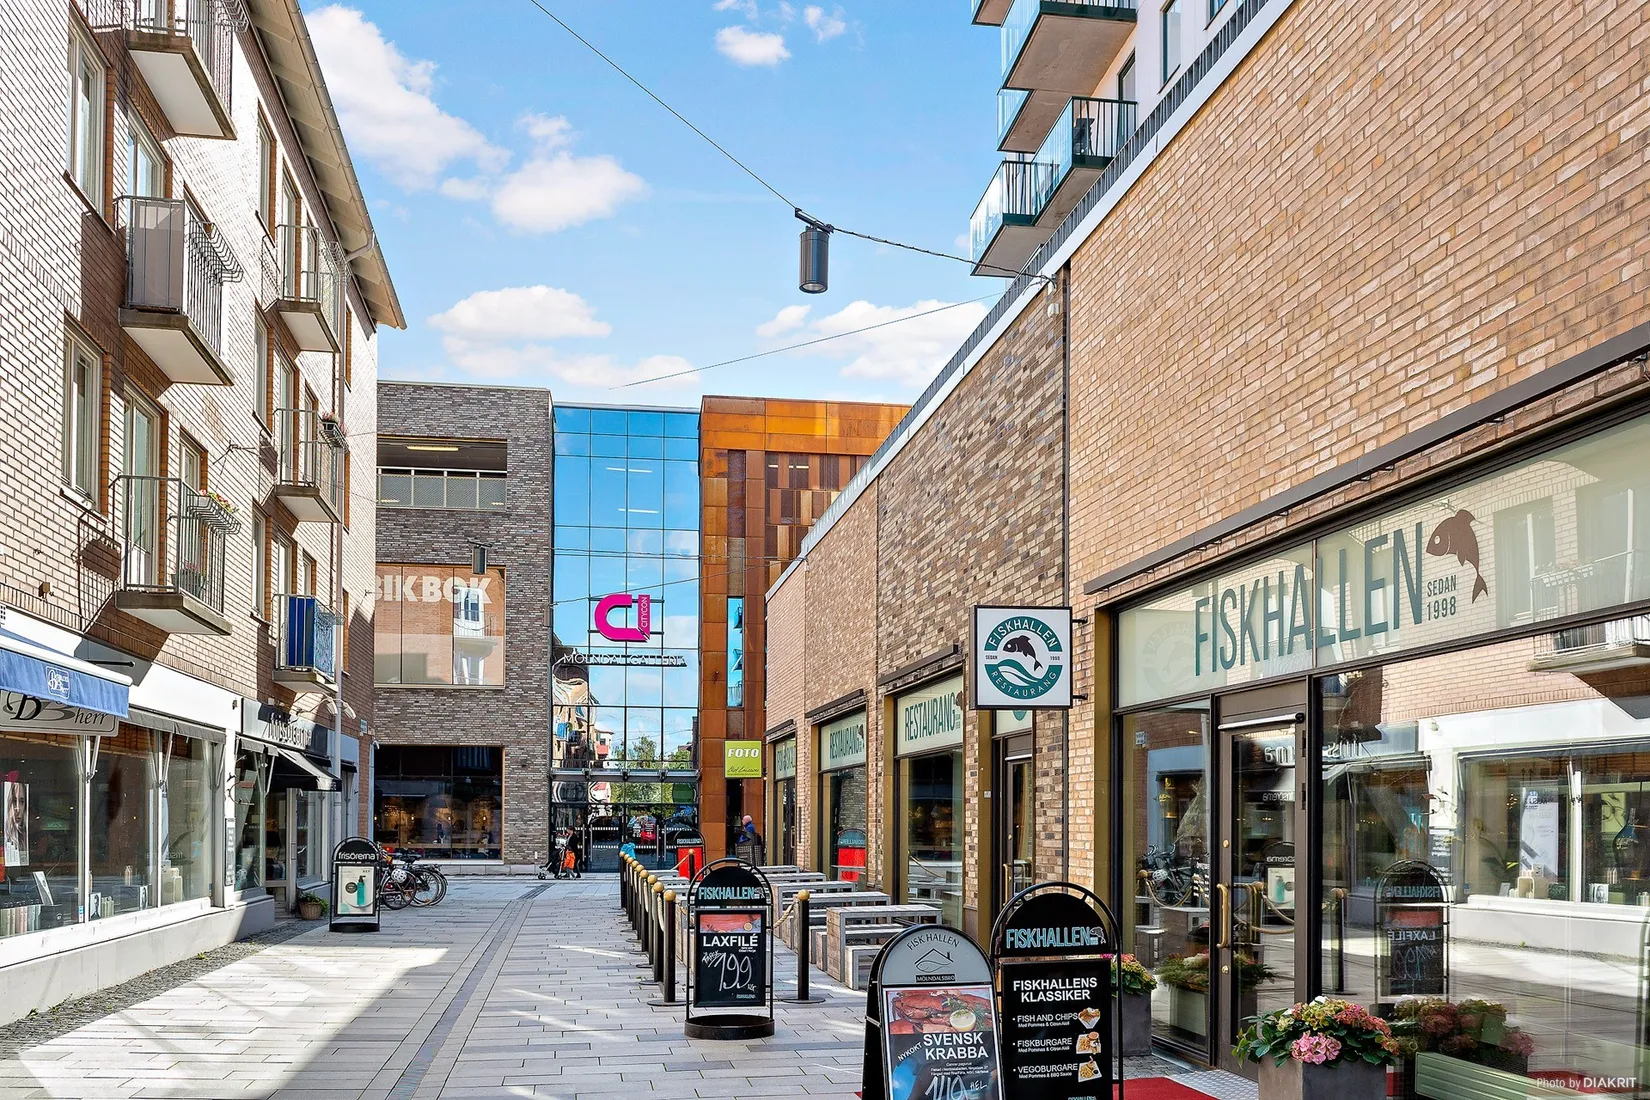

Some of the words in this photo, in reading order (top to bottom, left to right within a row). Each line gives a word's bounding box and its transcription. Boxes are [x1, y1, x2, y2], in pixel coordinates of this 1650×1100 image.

[1427, 574, 1457, 598] SEDAN
[1195, 521, 1423, 676] FISKHALLEN
[1426, 596, 1457, 621] 1998
[988, 619, 1058, 648] FISKHALLEN
[991, 671, 1057, 697] RESTAURANG
[904, 691, 956, 742] RESTAURANG
[728, 748, 759, 758] FOTO
[698, 886, 755, 900] FISKHALLEN
[703, 933, 759, 947] LAXFILÉ
[906, 936, 925, 950] FISK
[926, 933, 960, 948] HALLEN
[1006, 926, 1091, 949] FISKHALLEN
[713, 952, 753, 991] 199
[1013, 977, 1098, 991] FISKHALLENS
[1021, 989, 1091, 1003] KLASSIKER
[1017, 1015, 1036, 1023] FISH
[1036, 1014, 1054, 1022] AND
[1055, 1012, 1078, 1021] CHIPS
[923, 1032, 984, 1046] SVENSK
[1017, 1038, 1073, 1047] FISKBURGARE
[897, 1041, 923, 1061] NYKOKT
[925, 1046, 989, 1060] KRABBA
[1018, 1063, 1078, 1073] VEGOBURGARE
[970, 1080, 988, 1091] HEL
